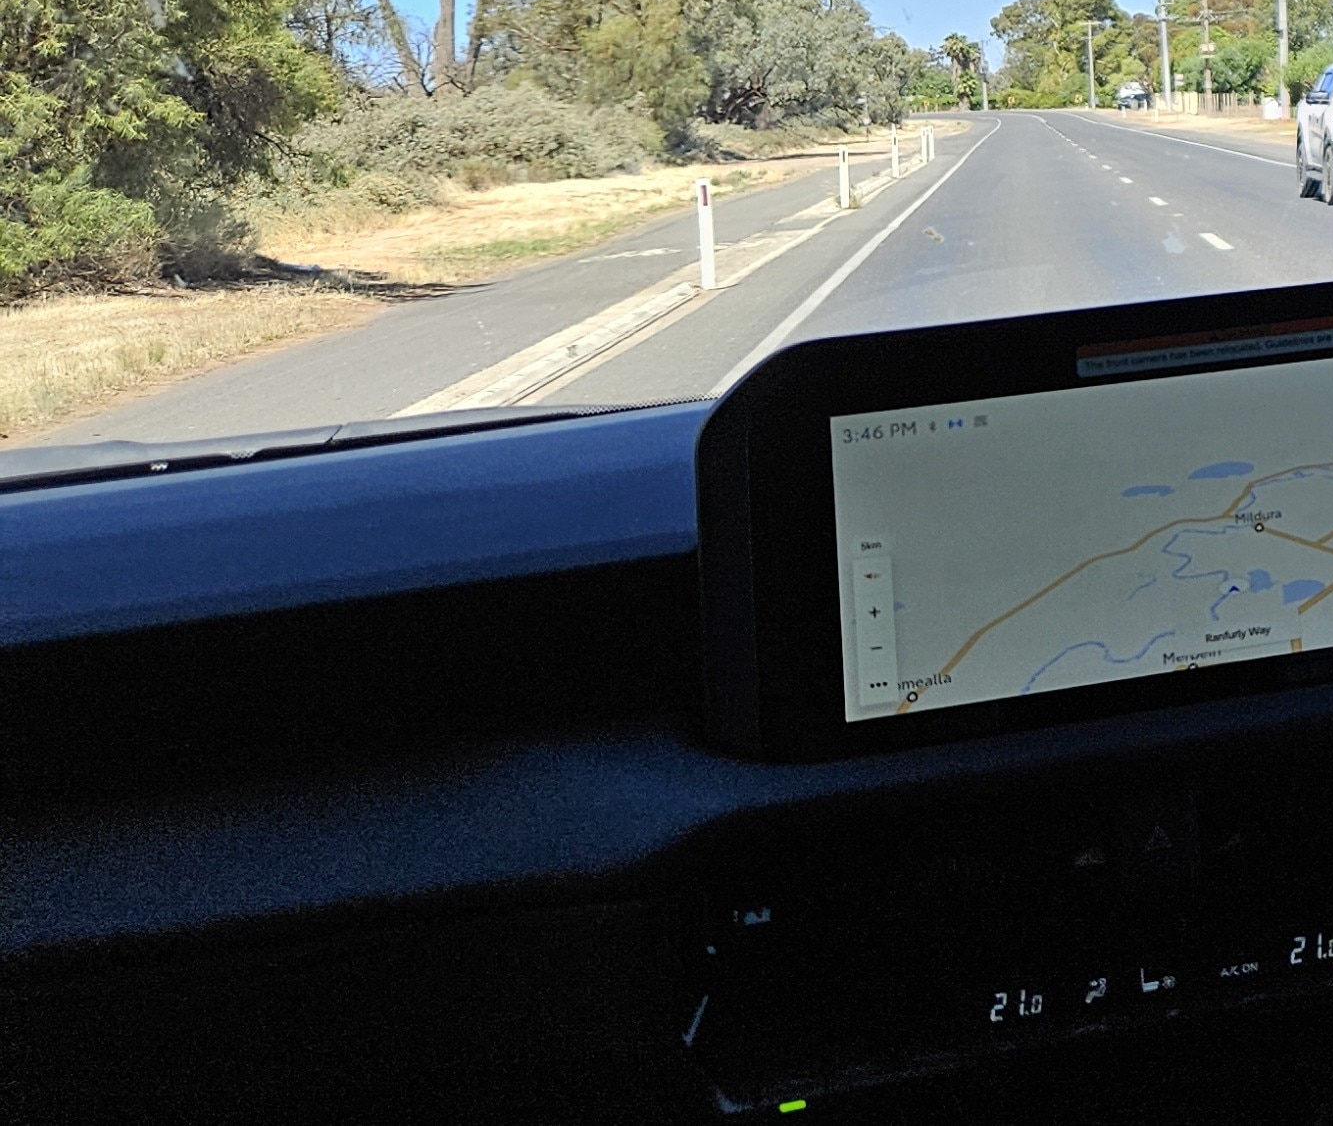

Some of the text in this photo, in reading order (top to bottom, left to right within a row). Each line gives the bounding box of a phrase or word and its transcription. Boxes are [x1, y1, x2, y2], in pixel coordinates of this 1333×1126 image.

[842, 421, 917, 444] 3:46 PM
[1234, 510, 1282, 524] Mildura
[860, 541, 882, 551] 5km
[1248, 626, 1271, 638] Way
[1242, 961, 1259, 974] ON
[990, 988, 1044, 1023] 21.0
